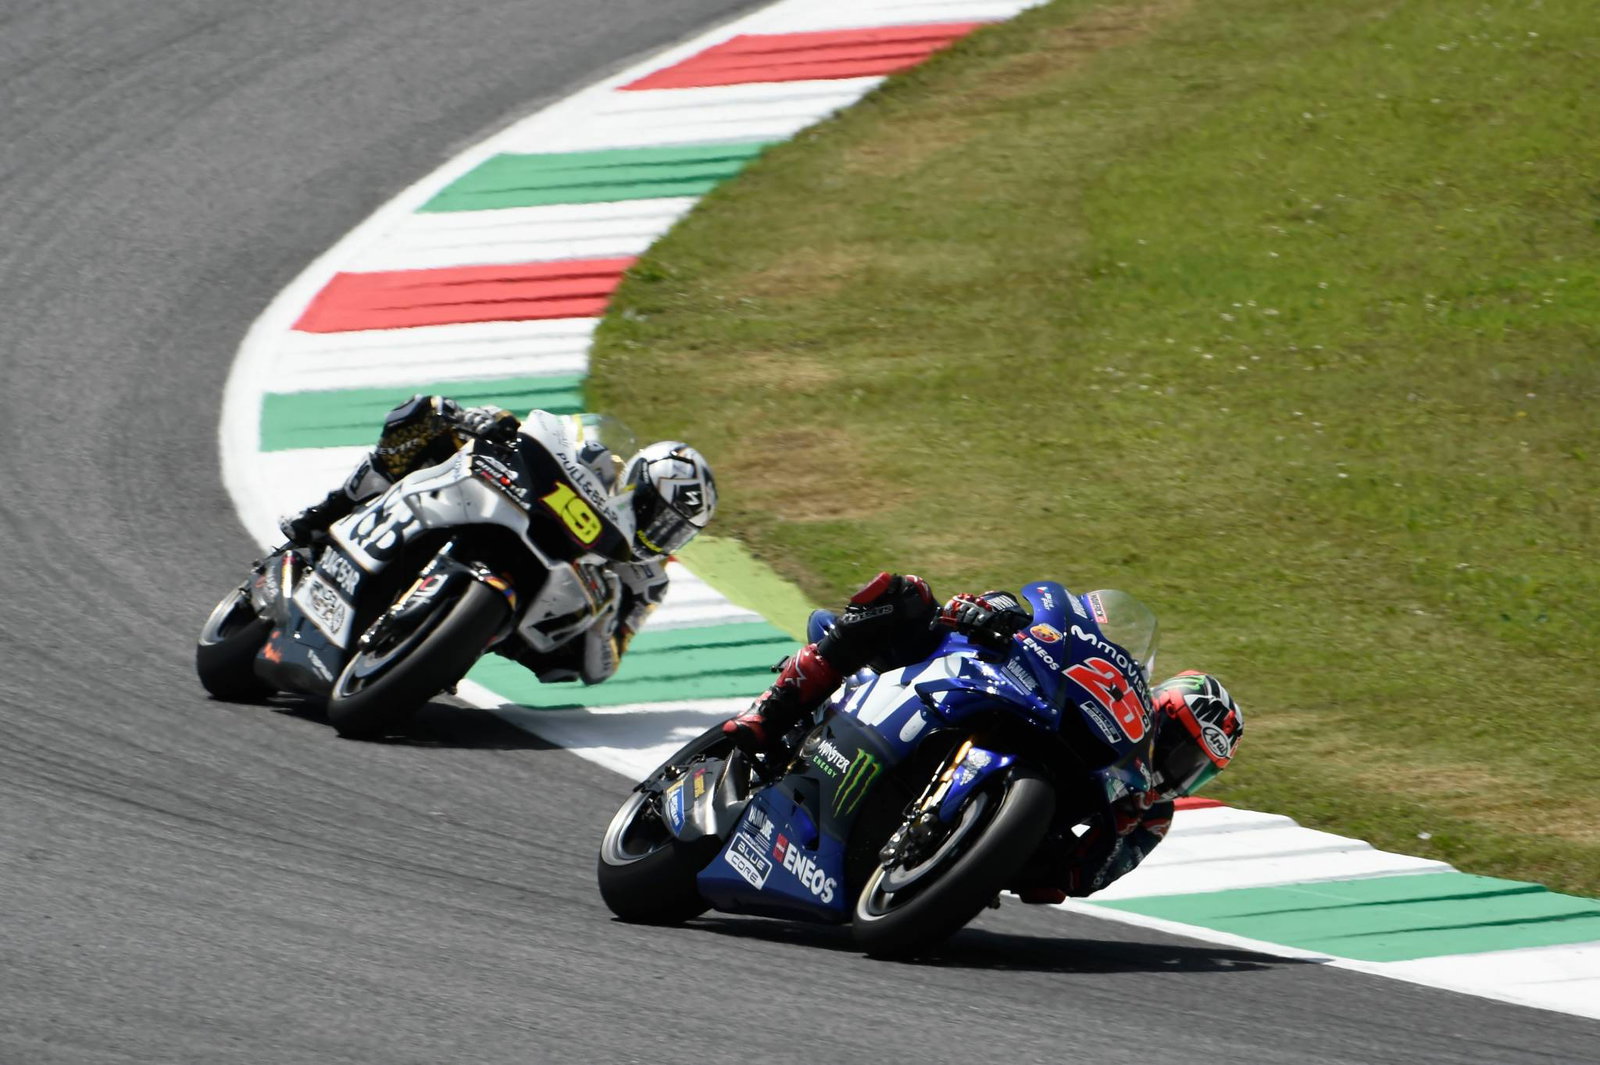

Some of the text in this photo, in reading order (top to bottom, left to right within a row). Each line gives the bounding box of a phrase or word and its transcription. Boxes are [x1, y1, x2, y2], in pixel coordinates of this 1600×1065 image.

[541, 480, 603, 545] 19
[1022, 637, 1060, 671] ENEOS
[1007, 658, 1038, 691] YAMALUBE
[1061, 656, 1145, 743] 25
[818, 740, 850, 773] MONSTER
[1205, 728, 1227, 755] Arai
[813, 755, 837, 778] ENERGY
[731, 855, 759, 883] CORE
[737, 841, 765, 871] BLUE
[783, 842, 837, 903] ENEOS
